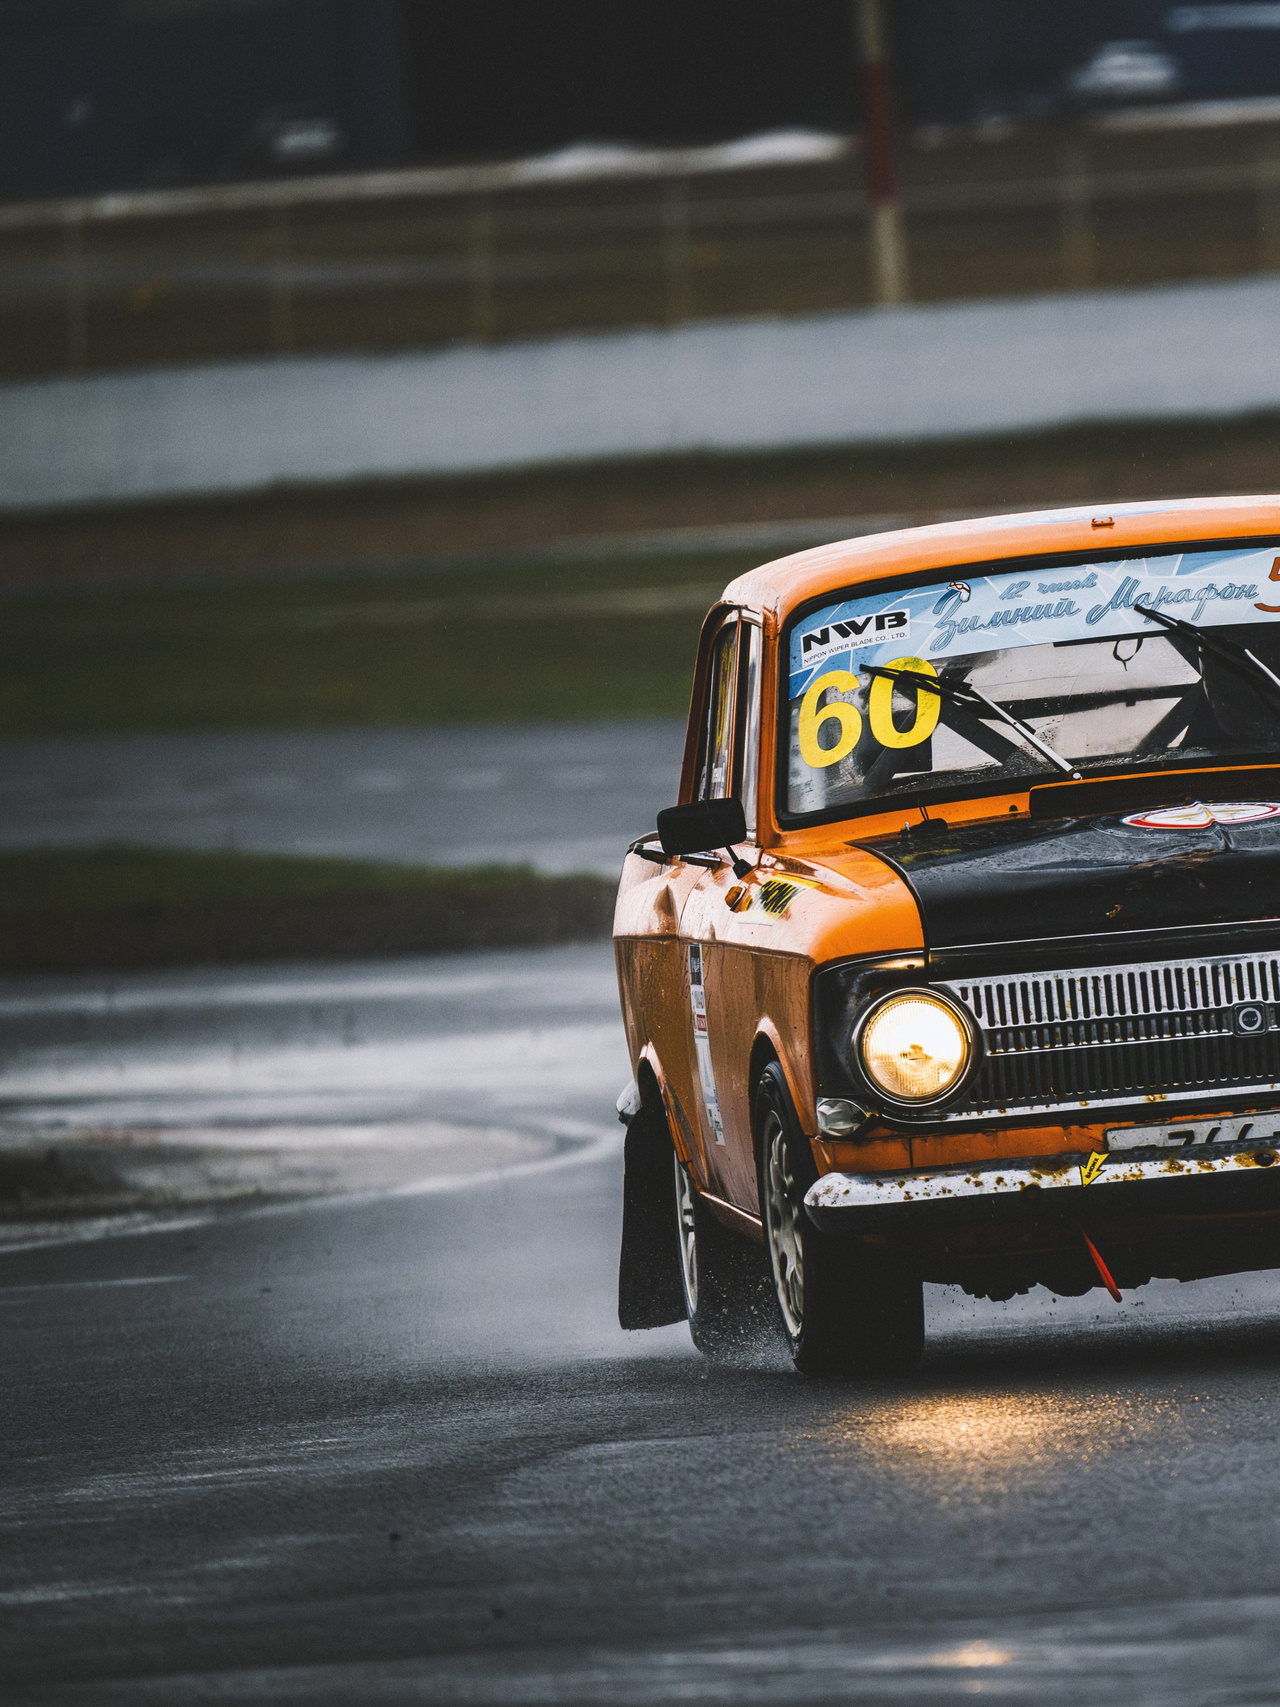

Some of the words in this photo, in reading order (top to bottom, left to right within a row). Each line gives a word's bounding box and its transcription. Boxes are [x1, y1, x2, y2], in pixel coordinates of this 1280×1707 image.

[802, 611, 908, 654] NWB
[929, 584, 1082, 651] Зимний
[1085, 576, 1260, 625] Марафон
[803, 650, 827, 664] NIPPON
[828, 643, 850, 654] WIPER
[850, 637, 874, 648] BLADE
[798, 656, 942, 769] 60
